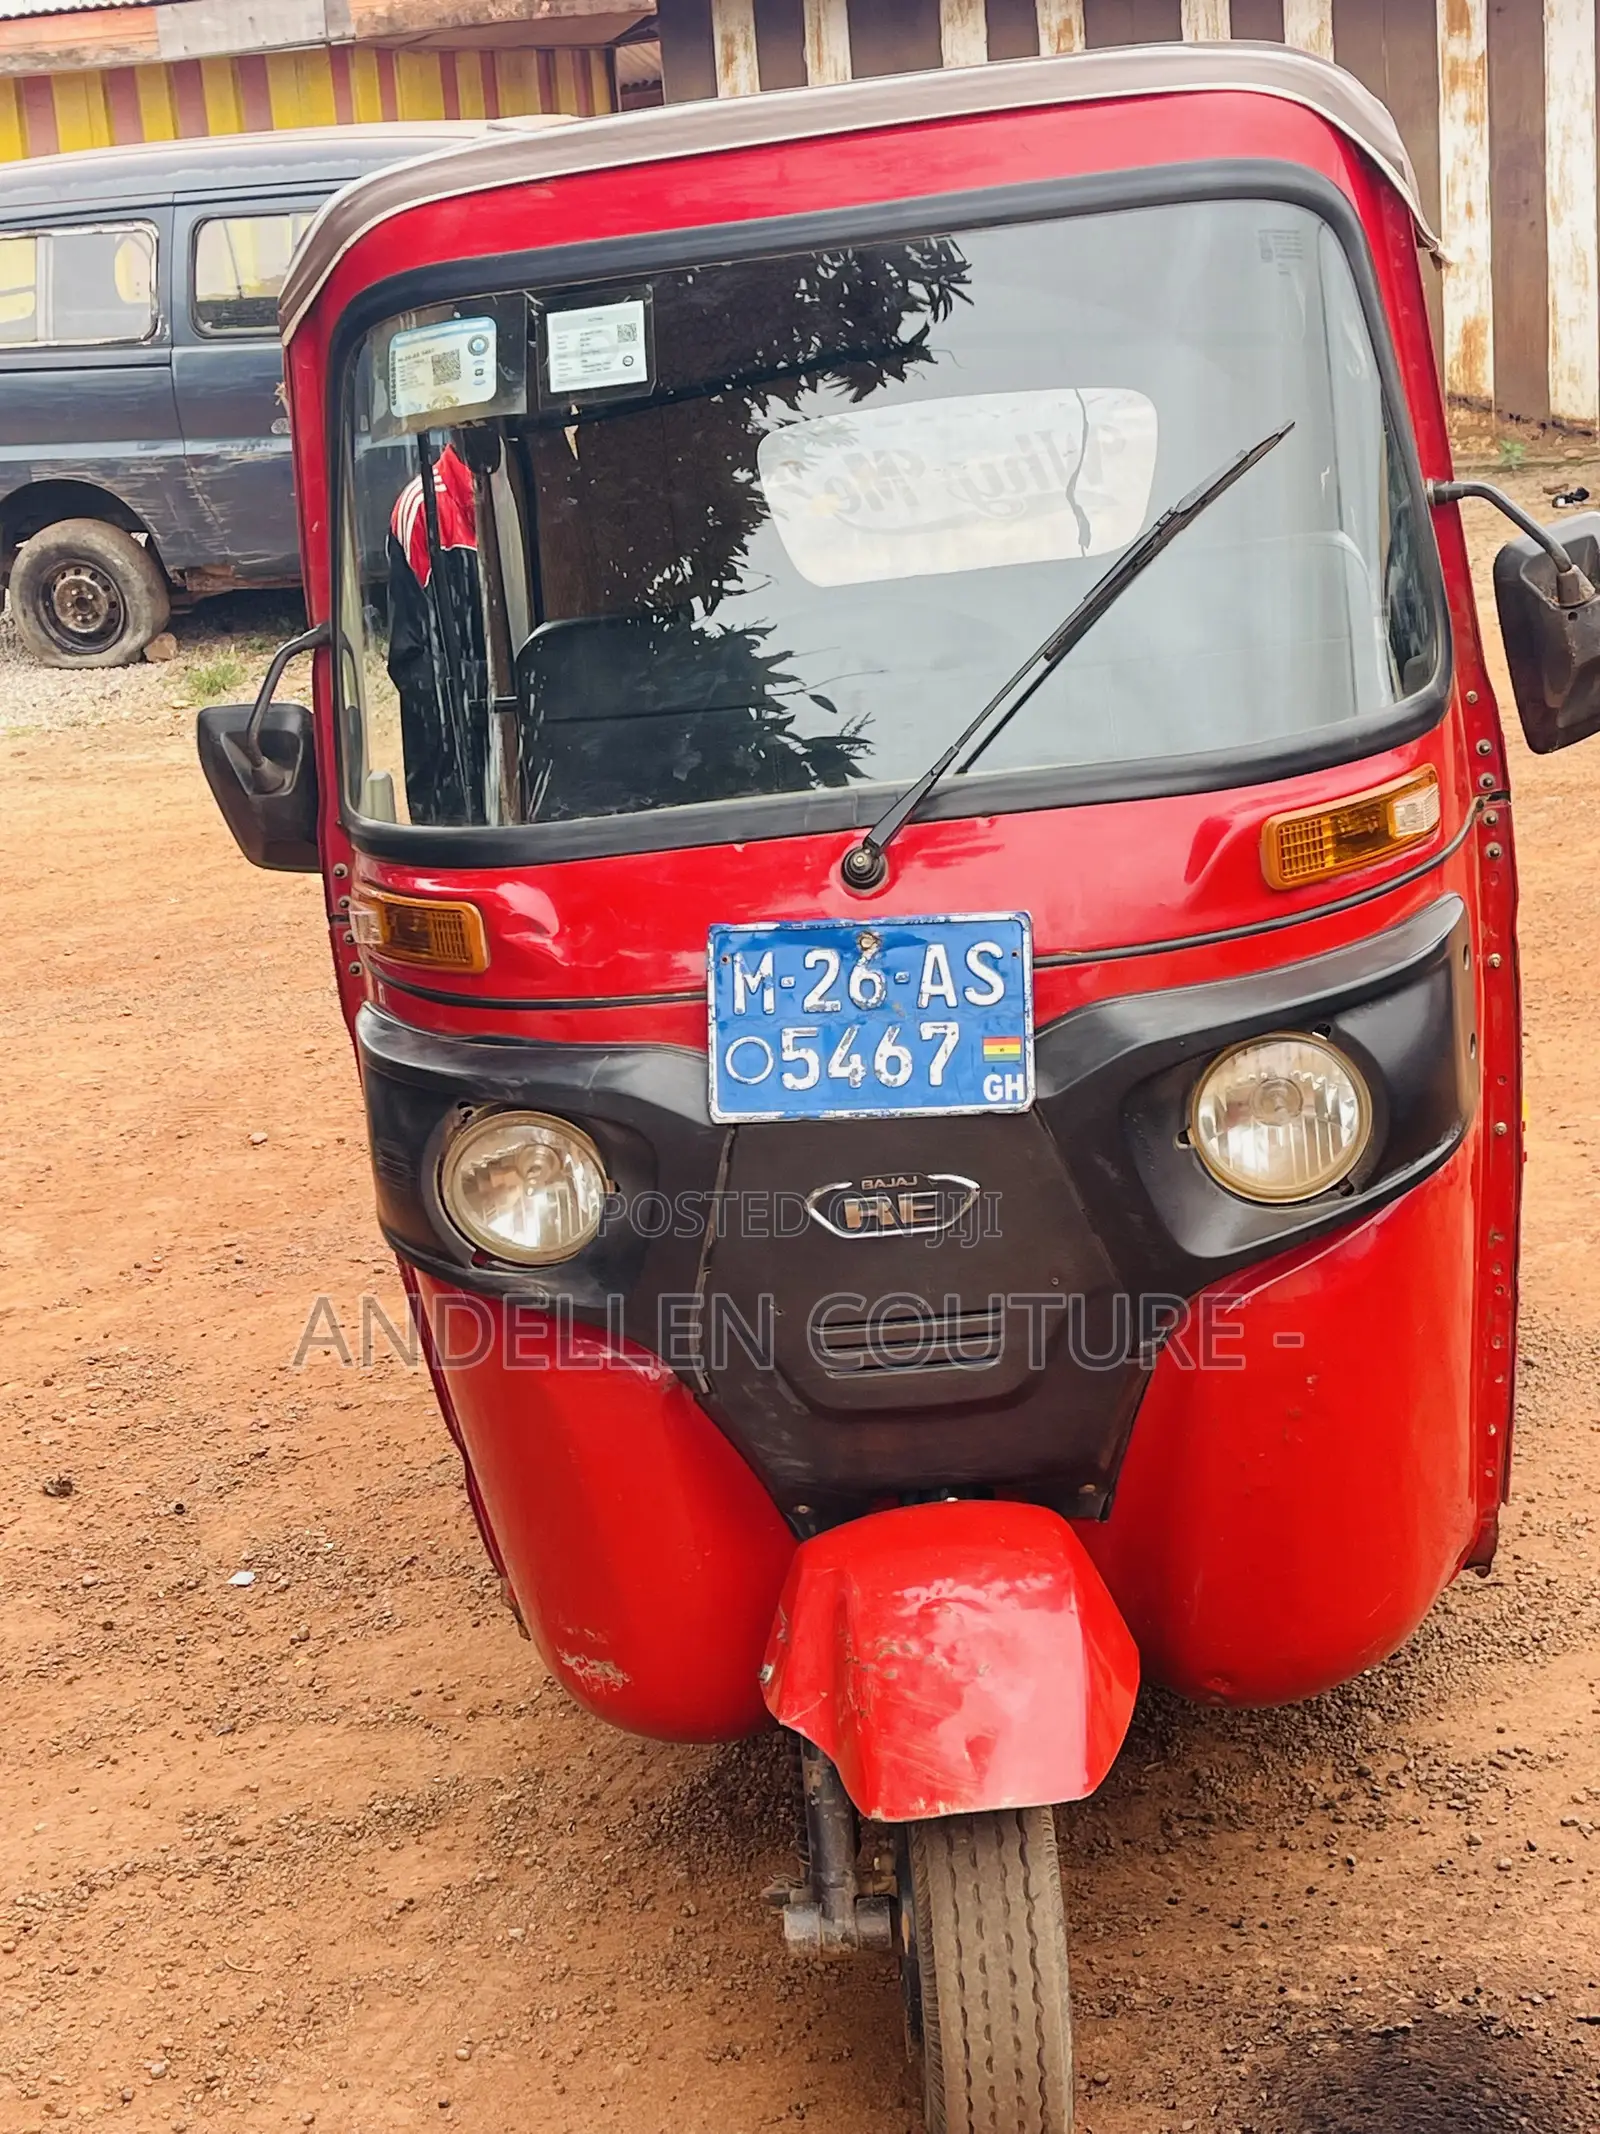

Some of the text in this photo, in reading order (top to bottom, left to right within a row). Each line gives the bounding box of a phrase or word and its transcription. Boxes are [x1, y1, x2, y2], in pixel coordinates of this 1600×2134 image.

[733, 941, 1006, 1016] M-26-AS
[781, 1022, 961, 1091] 5467
[982, 1073, 1026, 1102] GH
[861, 1175, 918, 1190] BAJAJ
[843, 1191, 942, 1229] RE
